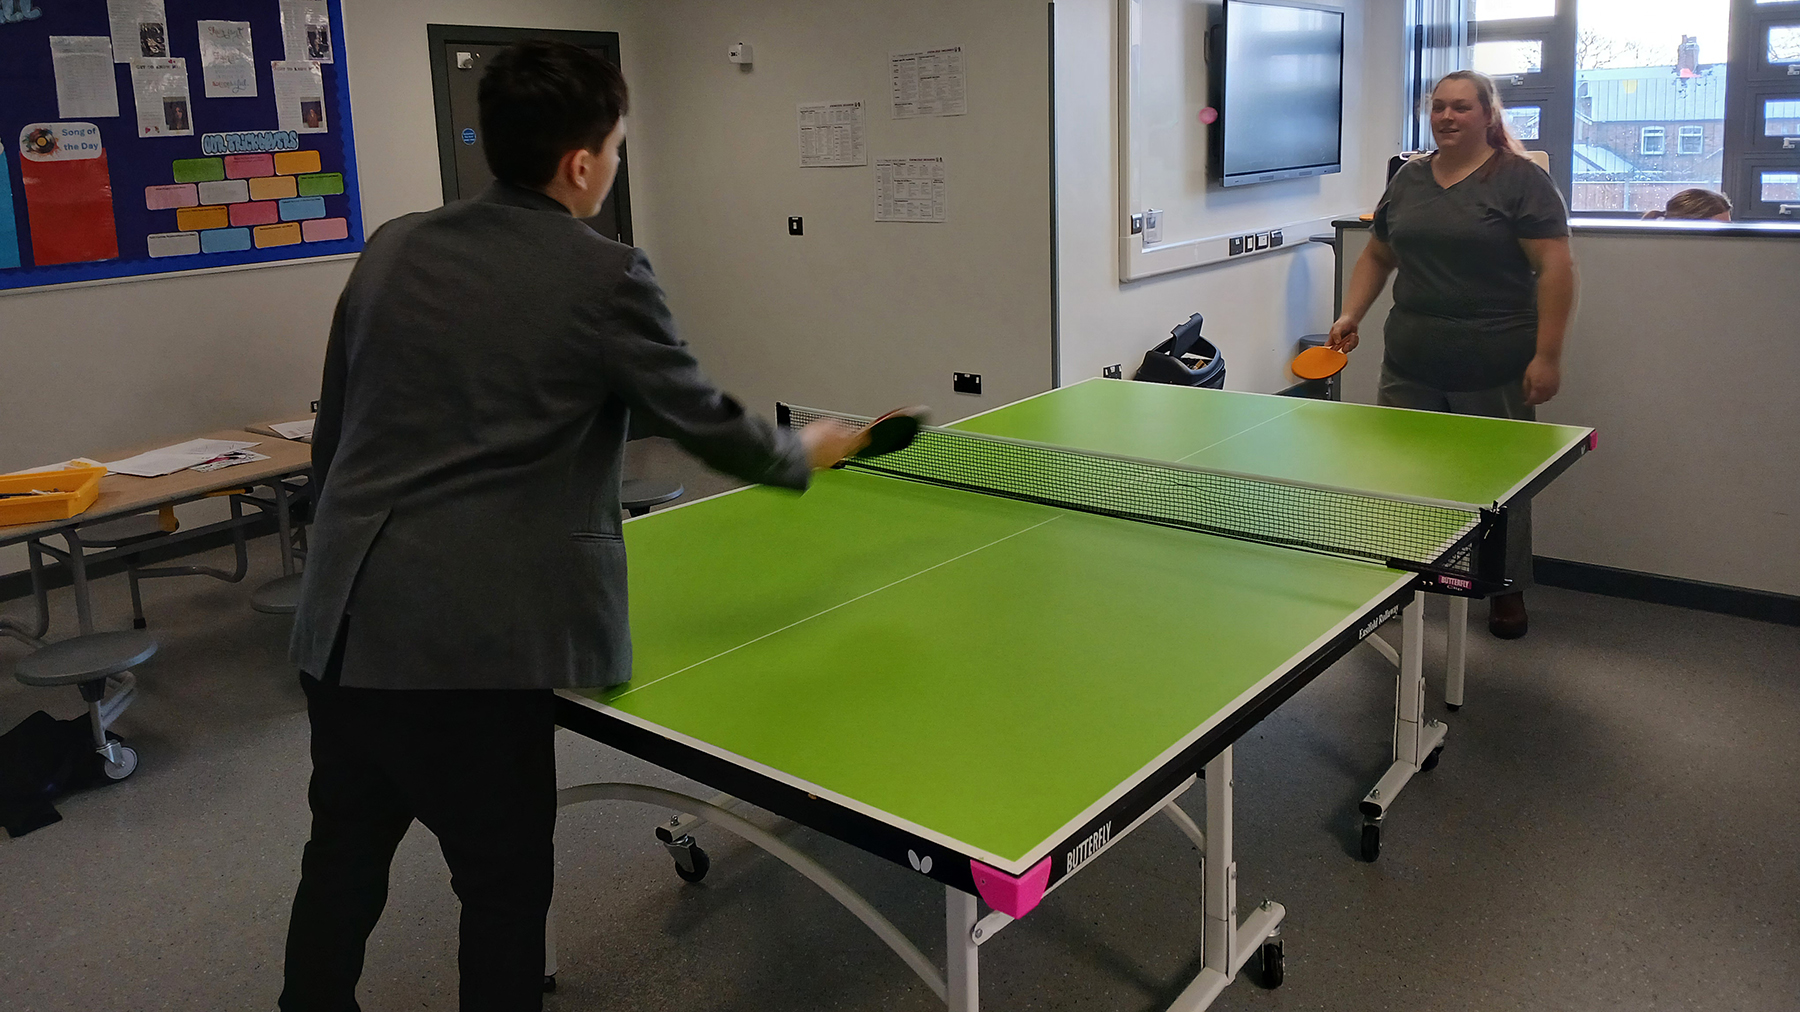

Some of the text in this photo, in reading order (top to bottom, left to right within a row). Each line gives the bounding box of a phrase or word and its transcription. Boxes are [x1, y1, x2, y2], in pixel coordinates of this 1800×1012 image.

[62, 129, 85, 137] Song
[82, 142, 98, 150] Day
[1441, 576, 1470, 588] BUTTERFLY
[1066, 820, 1112, 874] BUTTERFLY
